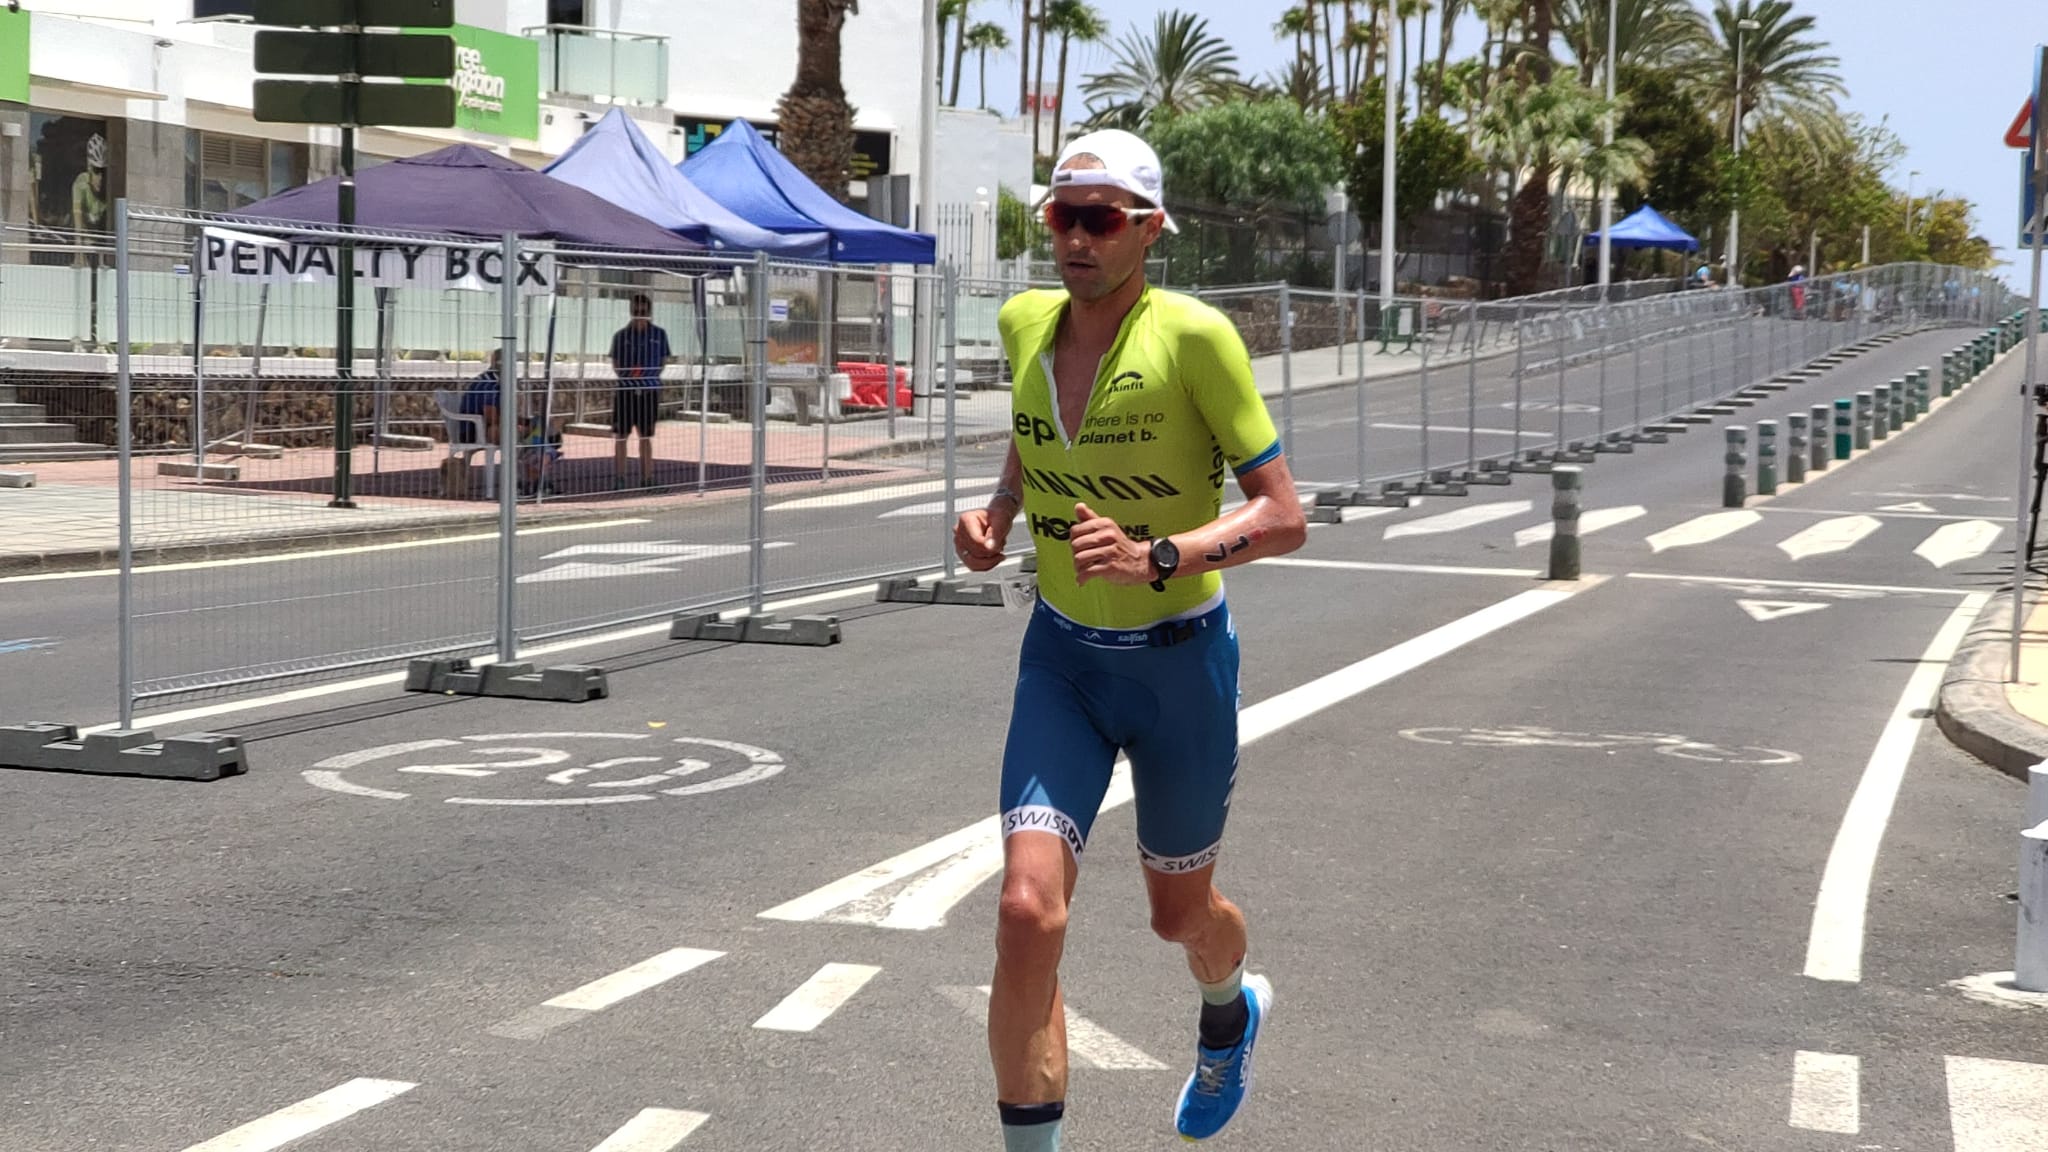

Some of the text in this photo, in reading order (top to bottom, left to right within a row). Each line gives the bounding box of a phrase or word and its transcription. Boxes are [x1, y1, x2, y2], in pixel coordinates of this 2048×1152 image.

[445, 246, 548, 287] BOX
[1126, 411, 1139, 425] is
[1144, 412, 1164, 424] no
[1079, 430, 1135, 446] planet
[1022, 464, 1181, 500] ANYON
